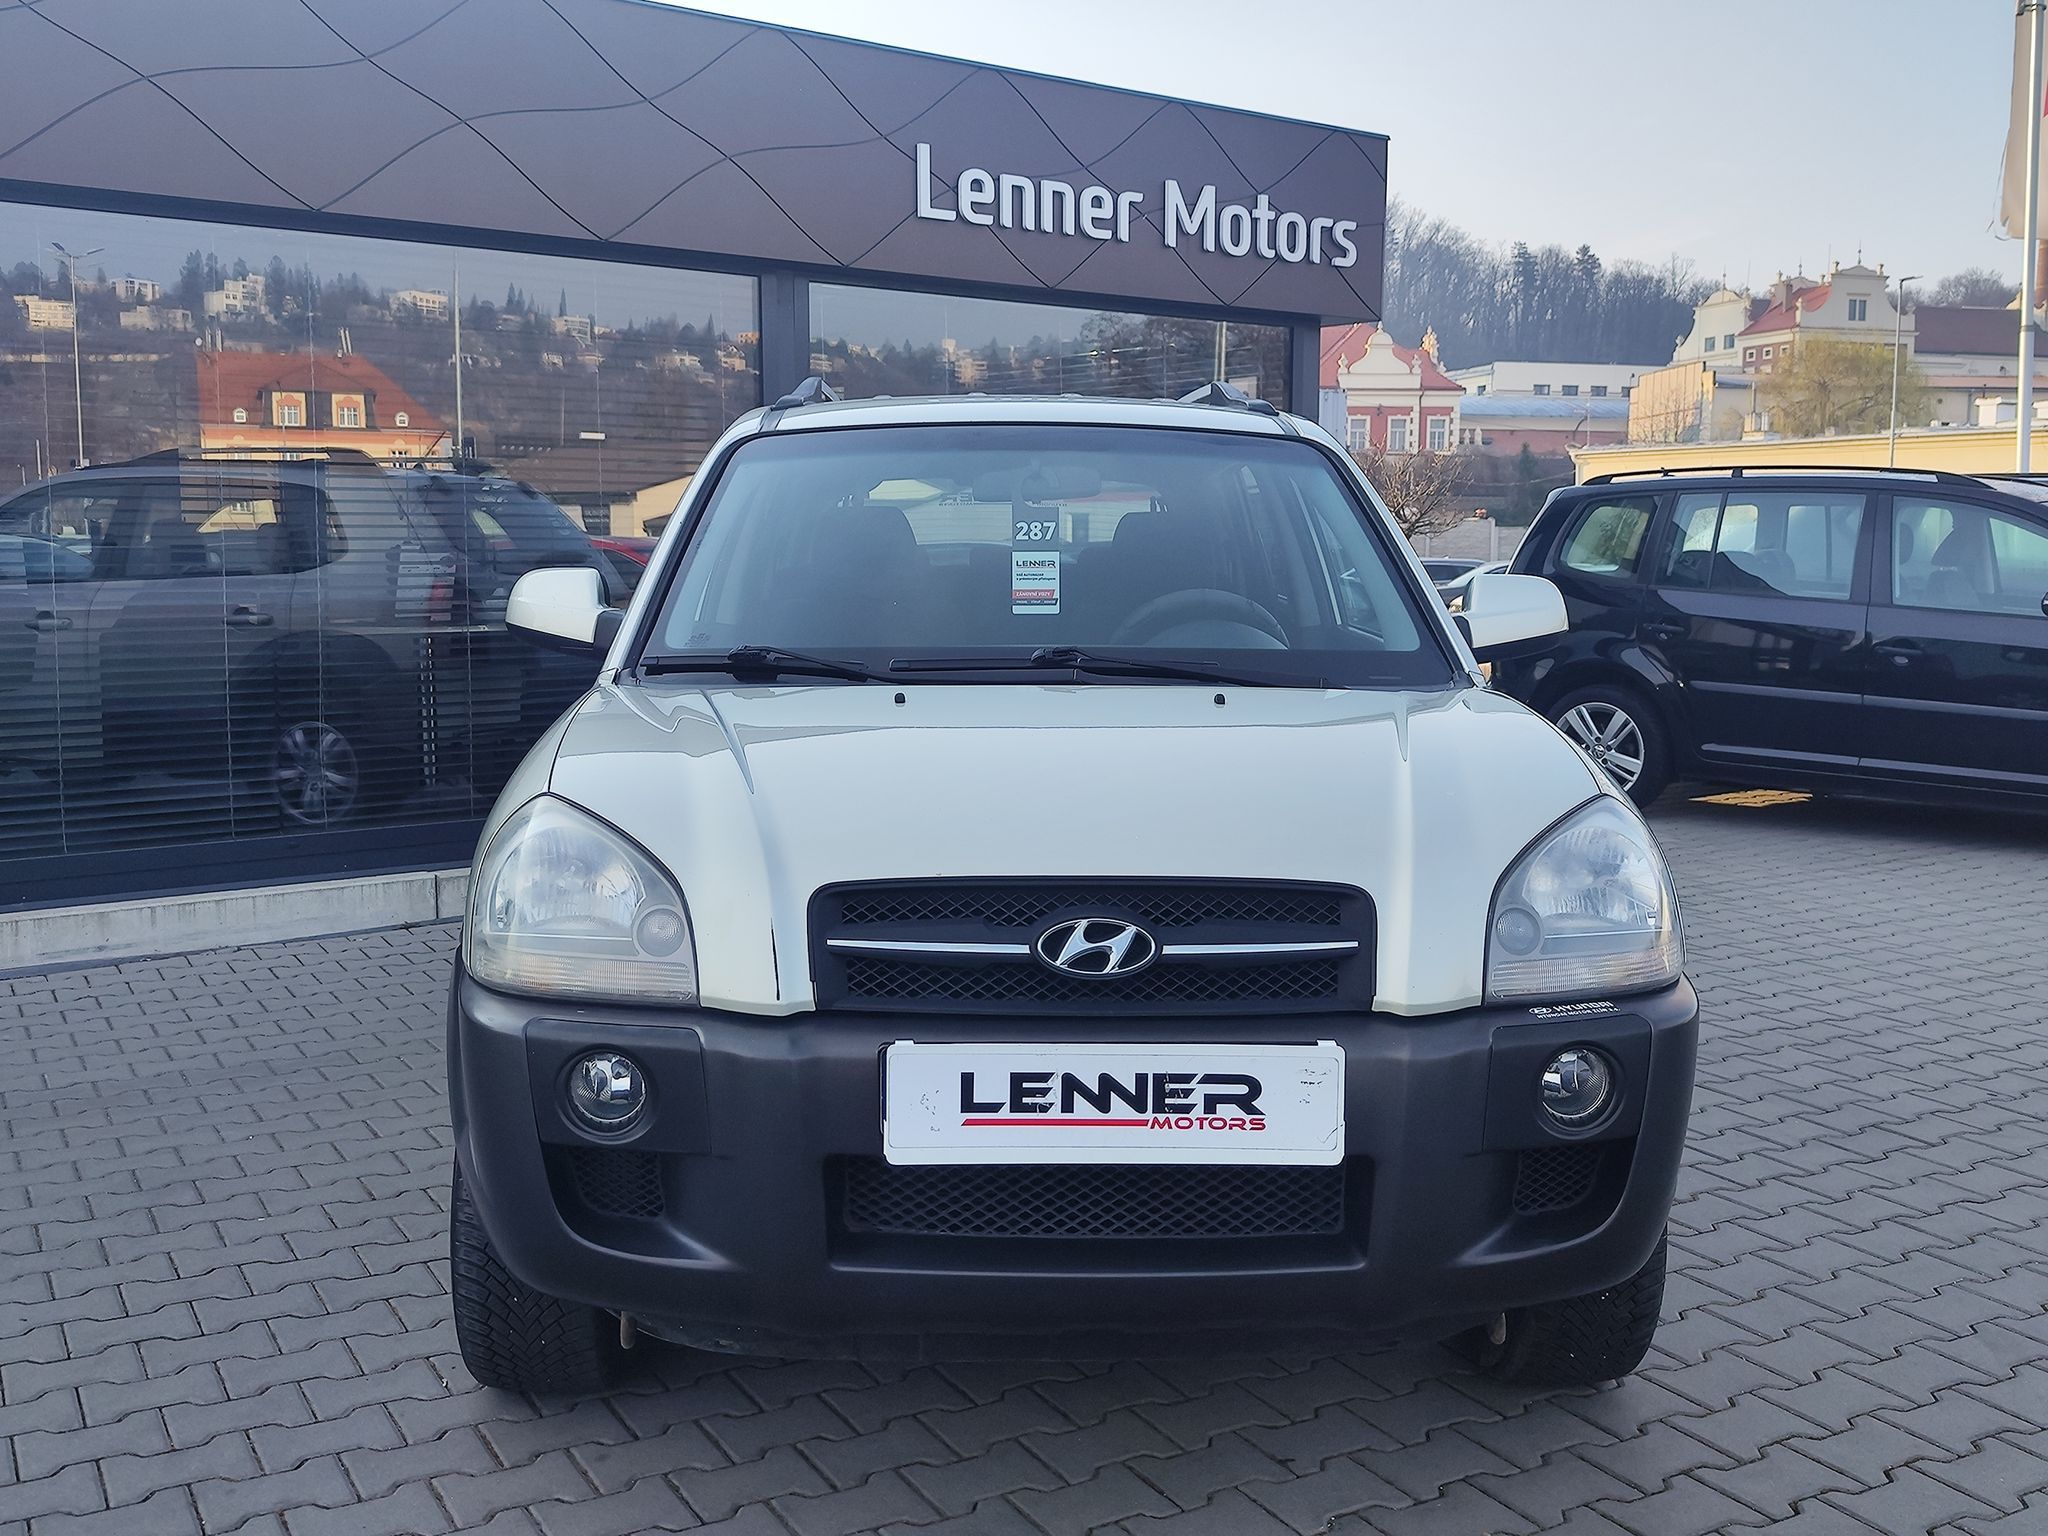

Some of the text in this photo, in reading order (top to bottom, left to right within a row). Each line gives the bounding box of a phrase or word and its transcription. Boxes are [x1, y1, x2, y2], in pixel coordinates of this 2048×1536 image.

[916, 142, 1358, 268] Lenner Motors
[1015, 521, 1056, 541] 287
[1015, 560, 1056, 569] LENNER
[1553, 1001, 1614, 1012] HYUNDAI
[960, 1071, 1266, 1116] LENNER
[1150, 1116, 1267, 1132] MOTORS
